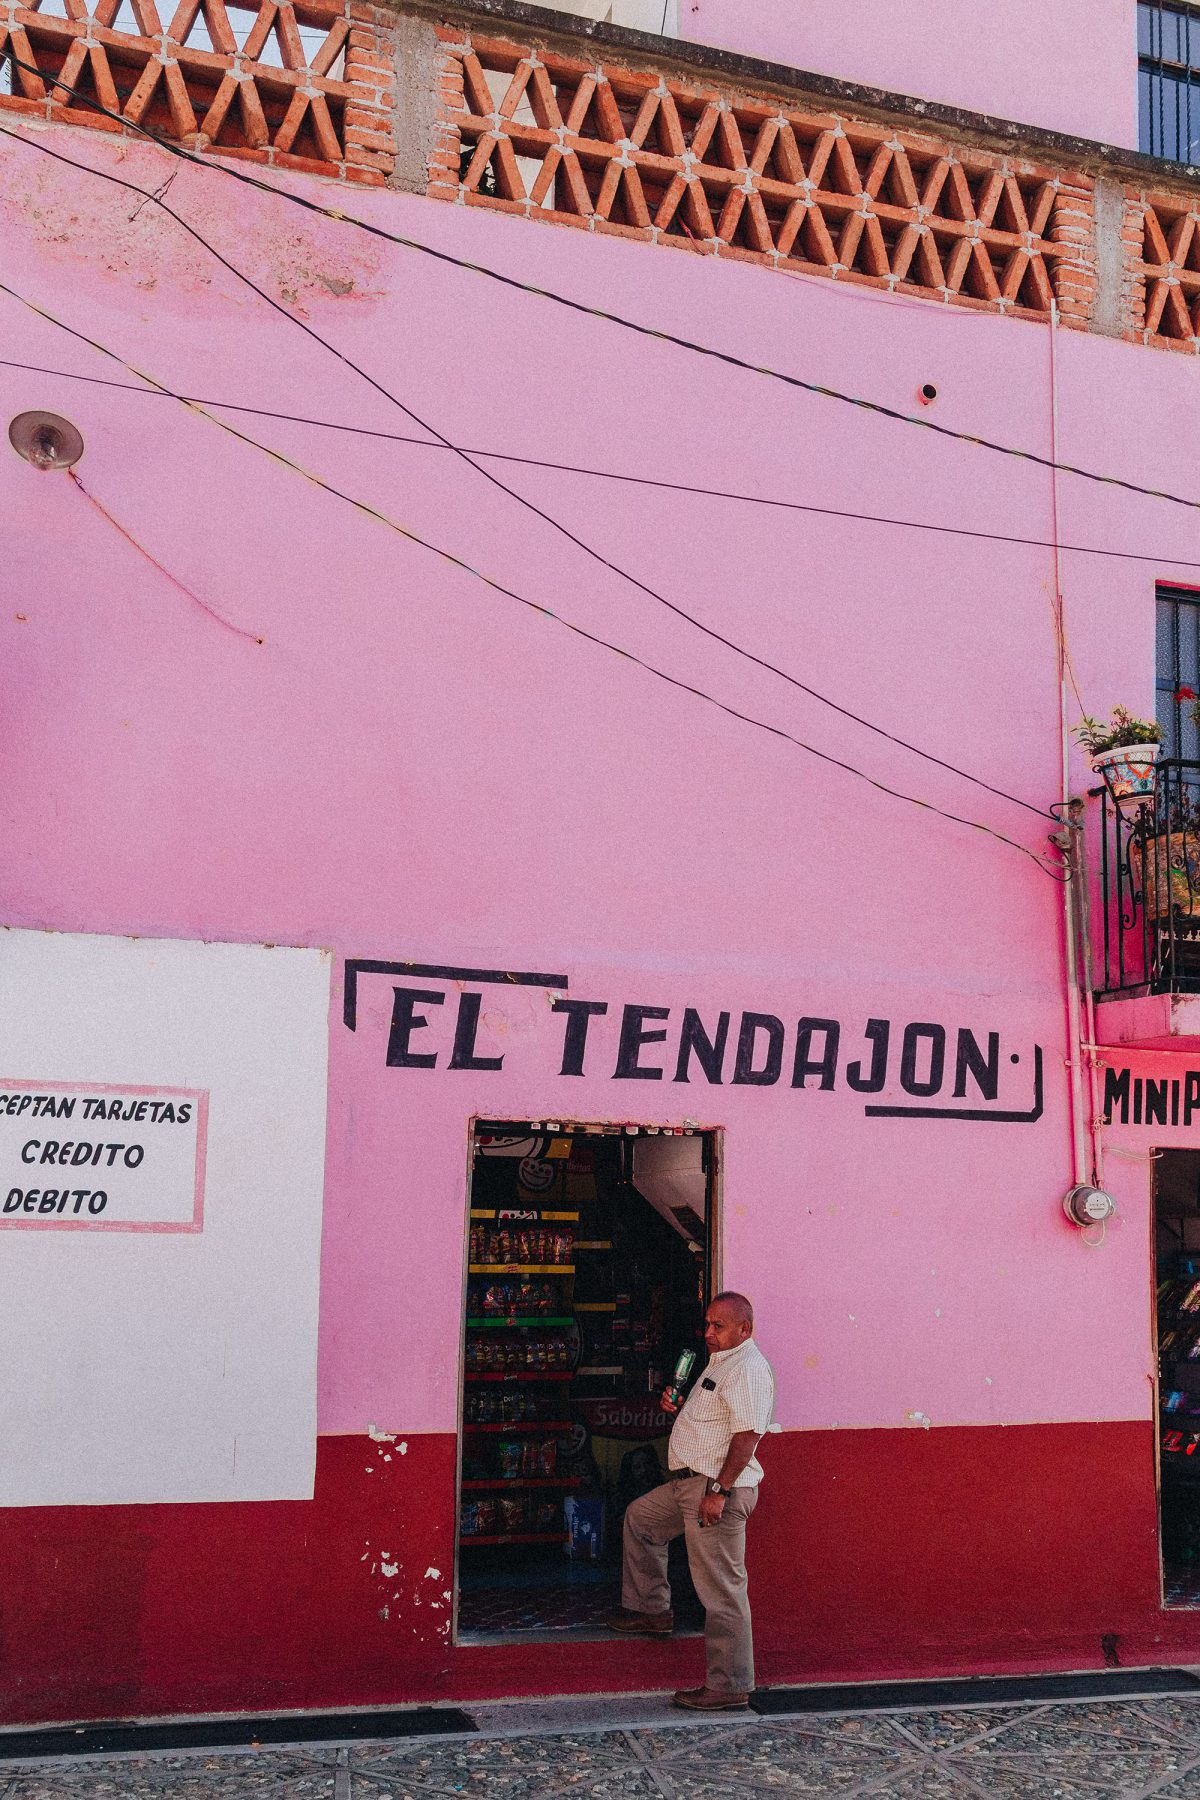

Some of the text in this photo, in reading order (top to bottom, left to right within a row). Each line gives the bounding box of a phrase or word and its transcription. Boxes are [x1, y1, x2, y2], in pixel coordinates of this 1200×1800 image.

[385, 986, 505, 1071] EL
[82, 1098, 193, 1124] TARJETAS
[21, 1139, 145, 1169] CREDITO
[2, 1187, 108, 1215] DEBITO
